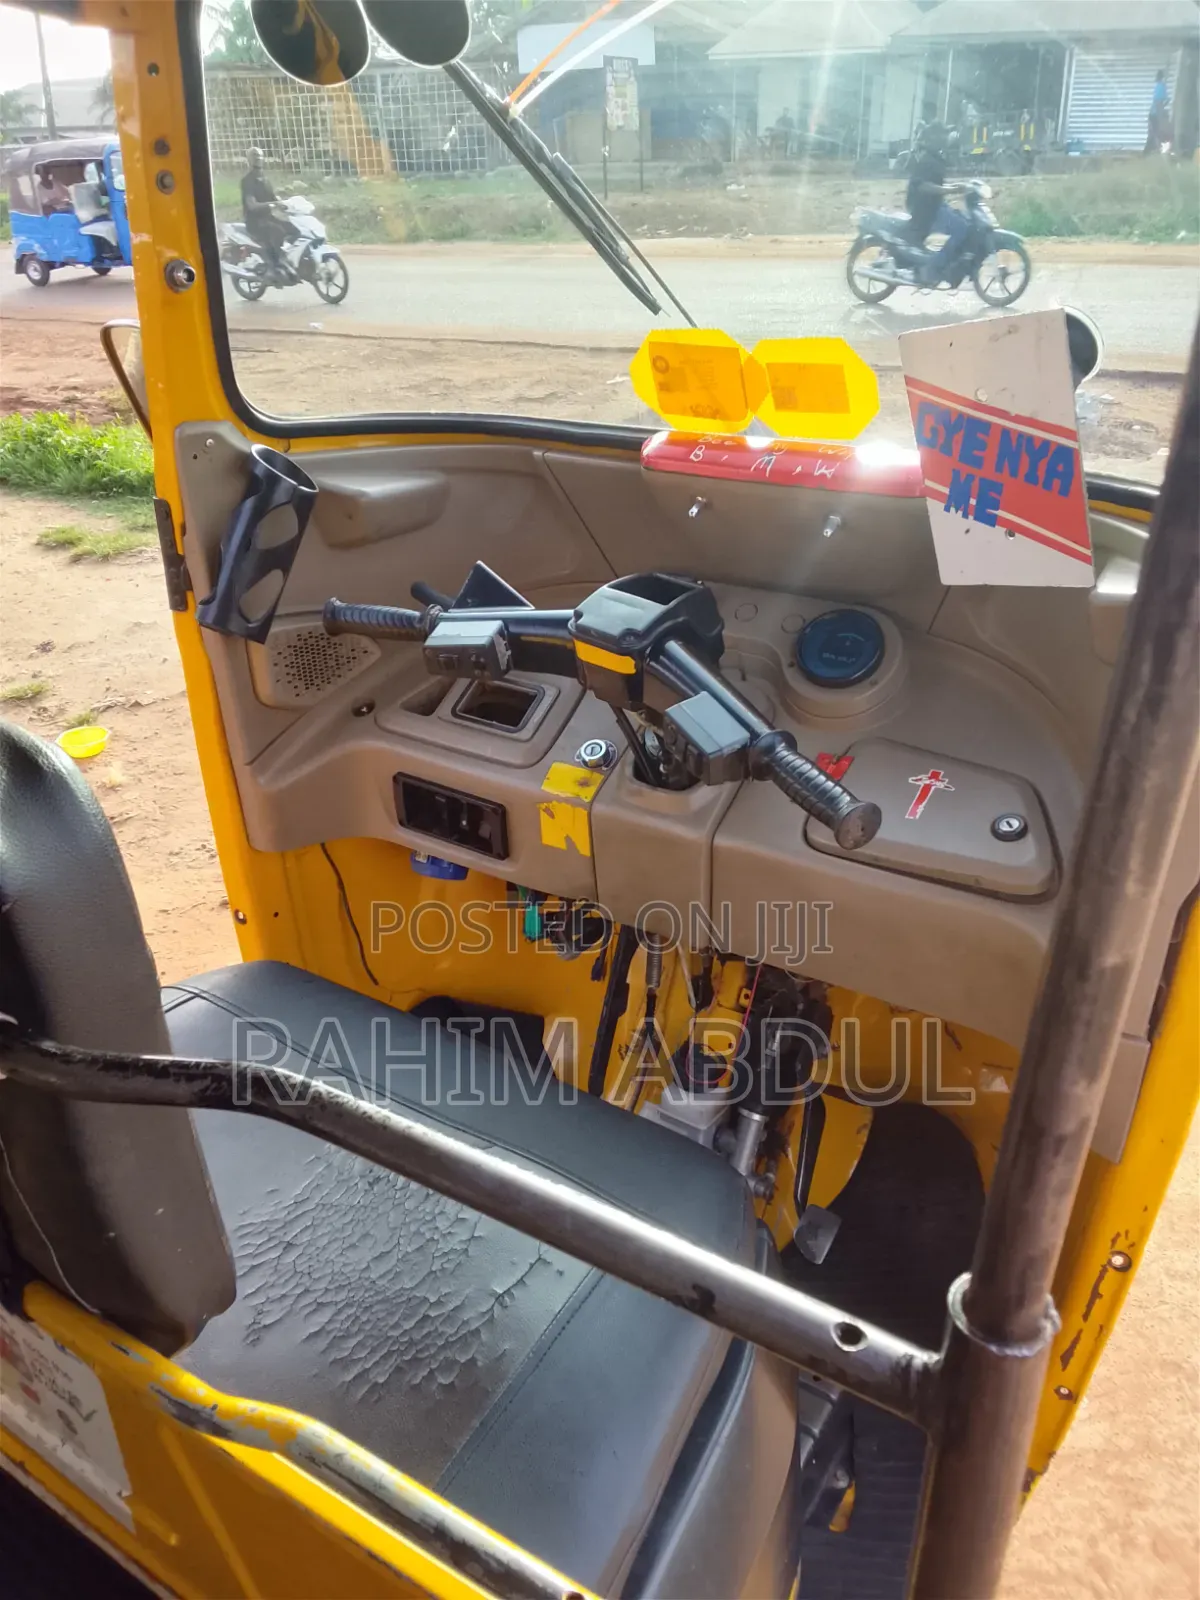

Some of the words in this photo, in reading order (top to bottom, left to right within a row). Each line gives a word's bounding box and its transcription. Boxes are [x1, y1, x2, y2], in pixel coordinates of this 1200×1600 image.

[915, 401, 992, 470] GYE
[995, 427, 1075, 498] NYA
[943, 468, 1004, 528] ME
